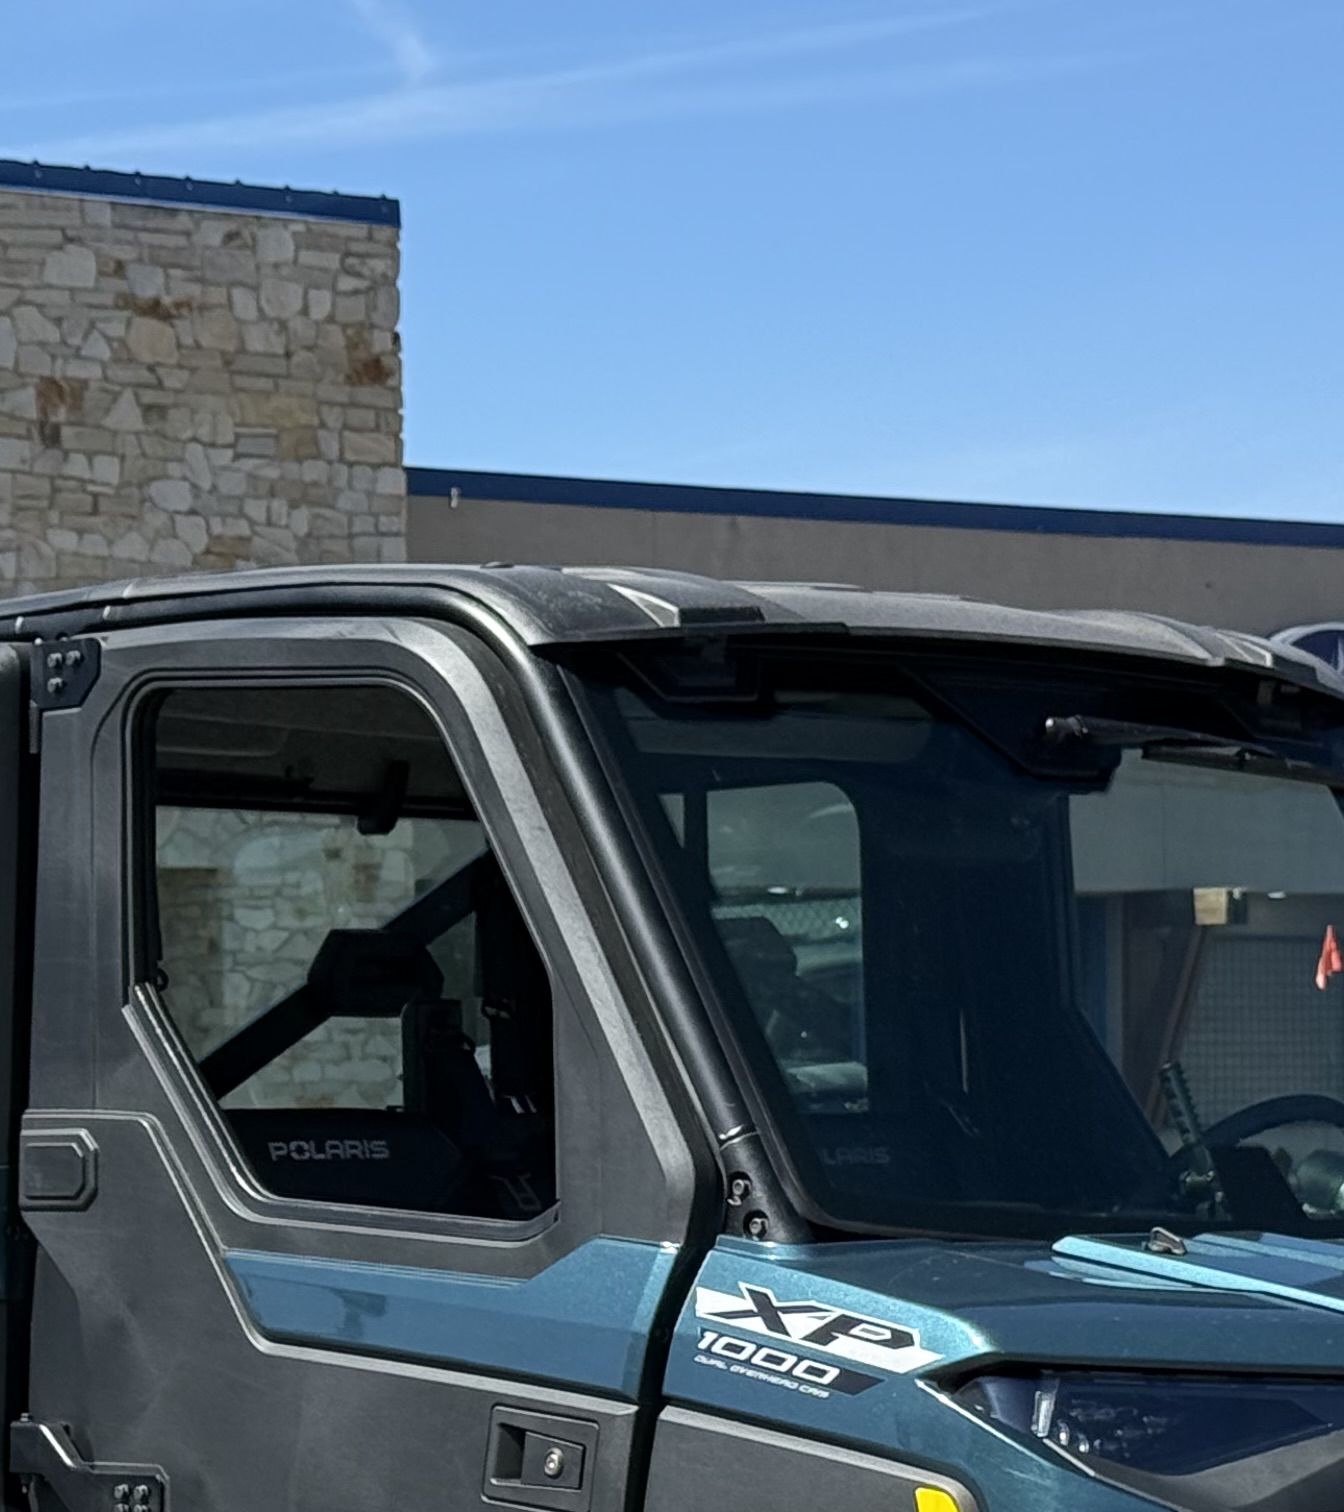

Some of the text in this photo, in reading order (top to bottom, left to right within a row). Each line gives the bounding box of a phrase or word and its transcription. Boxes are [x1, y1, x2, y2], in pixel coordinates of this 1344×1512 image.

[267, 1139, 391, 1162] POLARIS
[702, 1283, 920, 1352] XP
[694, 1354, 728, 1370] DUAL
[698, 1331, 840, 1386] 1000
